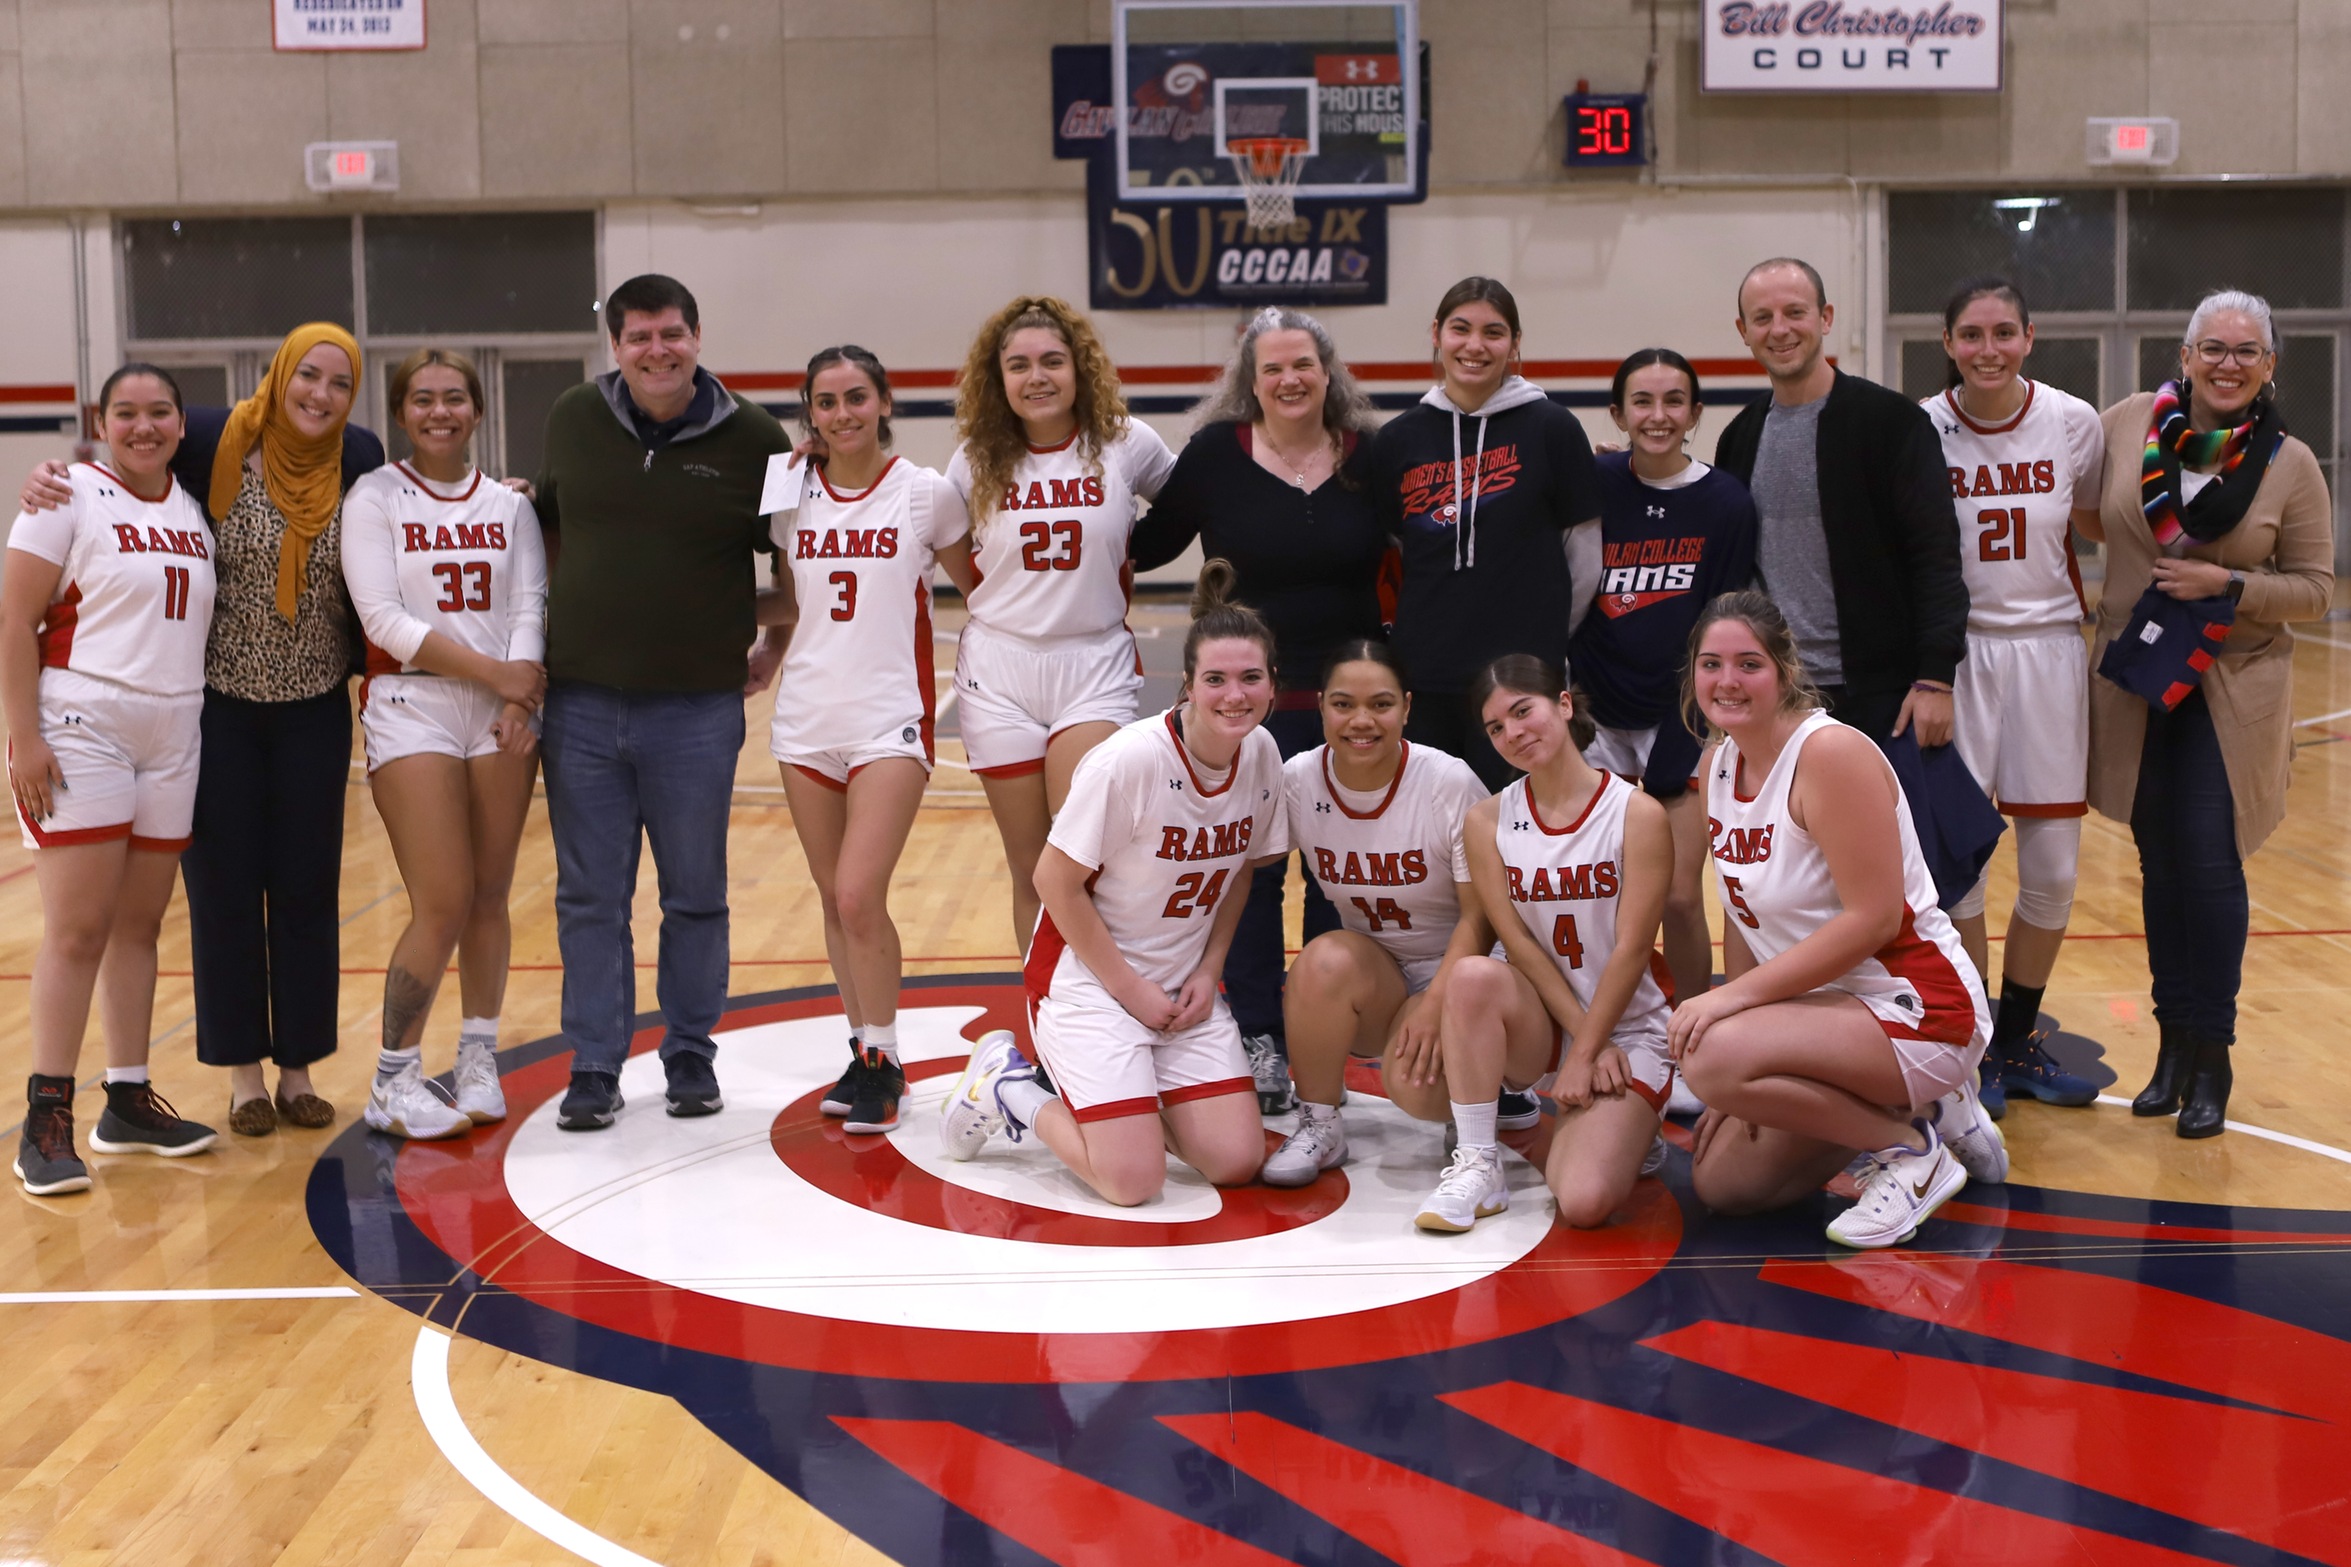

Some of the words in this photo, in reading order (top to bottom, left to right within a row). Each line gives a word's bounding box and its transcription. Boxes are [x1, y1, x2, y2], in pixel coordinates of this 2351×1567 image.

[1720, 0, 1791, 38] Bill
[1795, 0, 1985, 46] Christopher
[1754, 49, 1951, 69] COURT
[1319, 85, 1403, 112] PROTEC
[1355, 113, 1404, 133] HOUS
[1577, 107, 1630, 155] 30
[1320, 208, 1368, 243] IX
[1217, 248, 1333, 283] CCCAA
[999, 476, 1104, 511] RAMS
[1947, 460, 2055, 498] RAMS
[112, 523, 209, 561] RAMS
[402, 522, 507, 553] RAMS
[796, 527, 898, 560] RAMS
[1020, 520, 1082, 571] 23
[1639, 537, 1705, 565] COLLEGE
[1977, 507, 2026, 562] 21
[164, 566, 189, 620] 11
[432, 562, 491, 613] 33
[829, 571, 857, 622] 3
[1601, 564, 1696, 594] AMS
[1155, 815, 1253, 862] RAMS
[1708, 816, 1775, 865] RAMS
[1314, 846, 1428, 886] RAMS
[1505, 861, 1619, 903] RAMS
[1162, 868, 1230, 918] 24
[1723, 875, 1760, 929] 5
[1350, 897, 1412, 932] 14
[1553, 914, 1584, 970] 4
